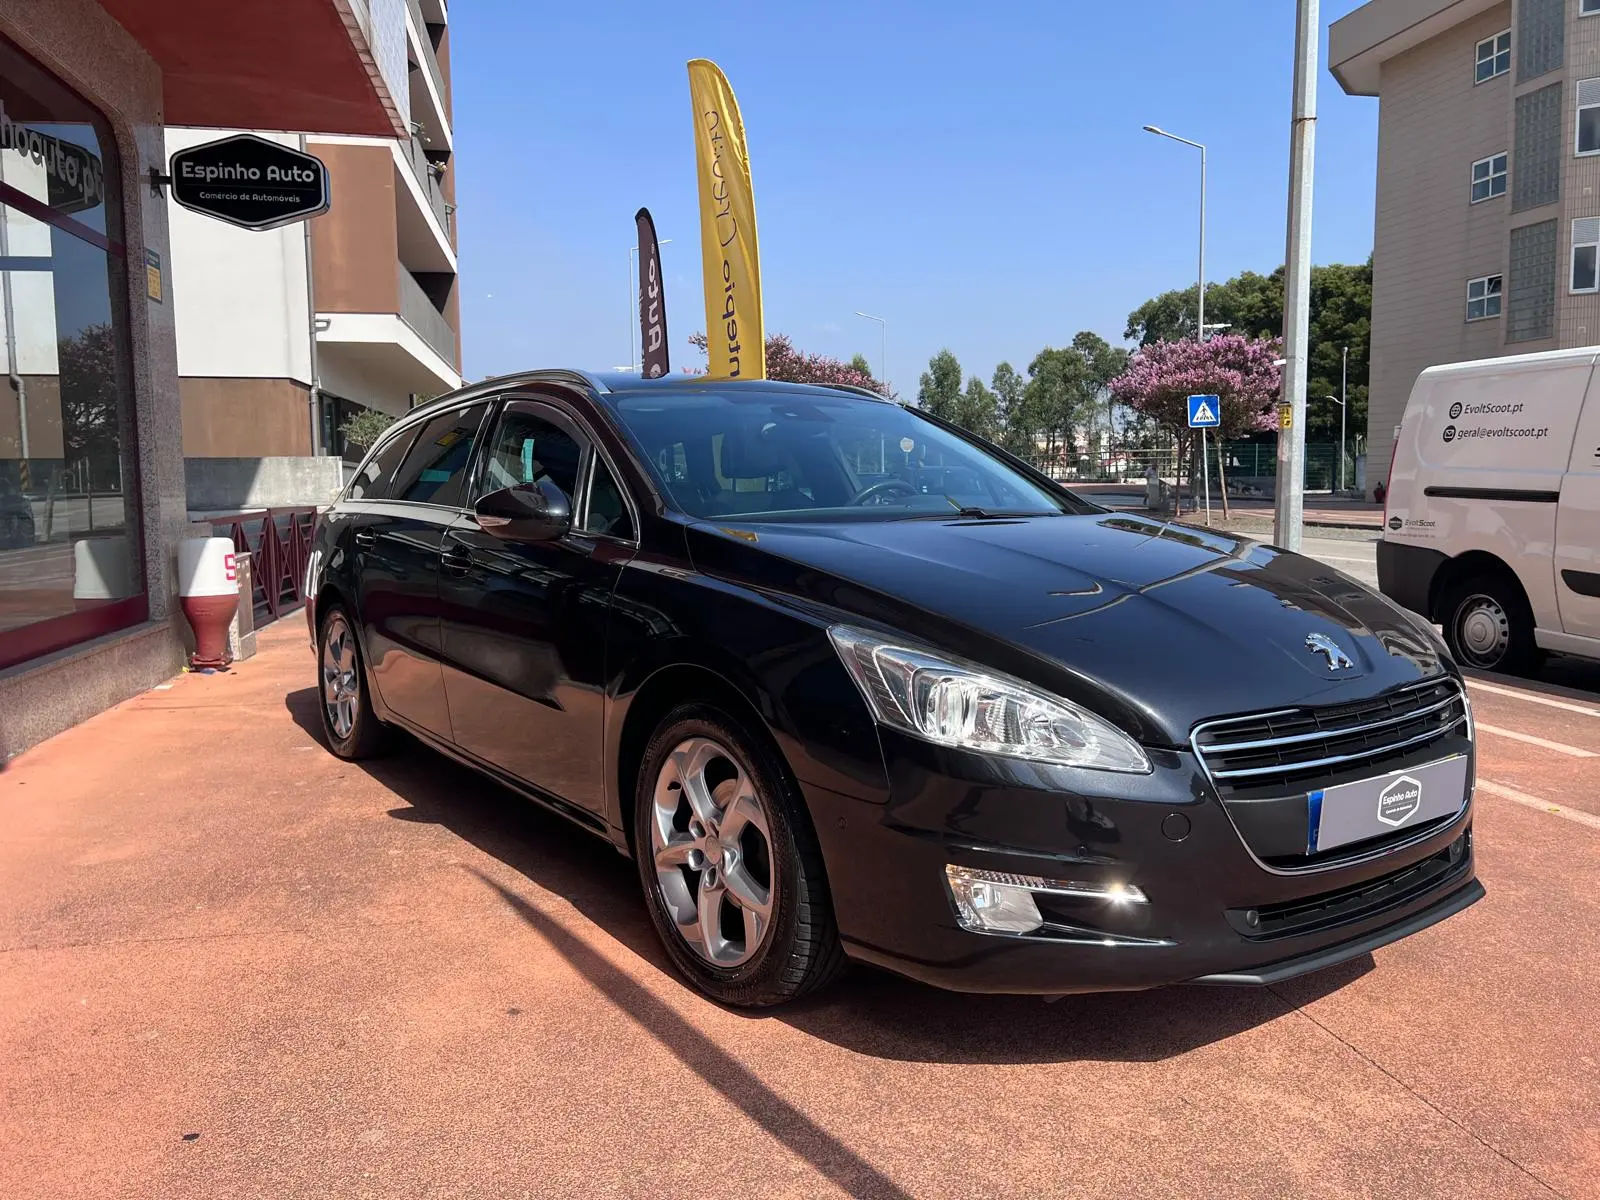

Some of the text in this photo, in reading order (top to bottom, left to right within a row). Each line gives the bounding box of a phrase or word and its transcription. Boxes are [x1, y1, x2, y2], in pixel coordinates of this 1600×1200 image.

[181, 161, 315, 182] Espinho Auto
[199, 191, 238, 200] Comércio
[239, 192, 250, 200] de
[1464, 403, 1523, 415] EvoltScoot.pt
[1457, 427, 1548, 439] geral@evoltscoot.pt
